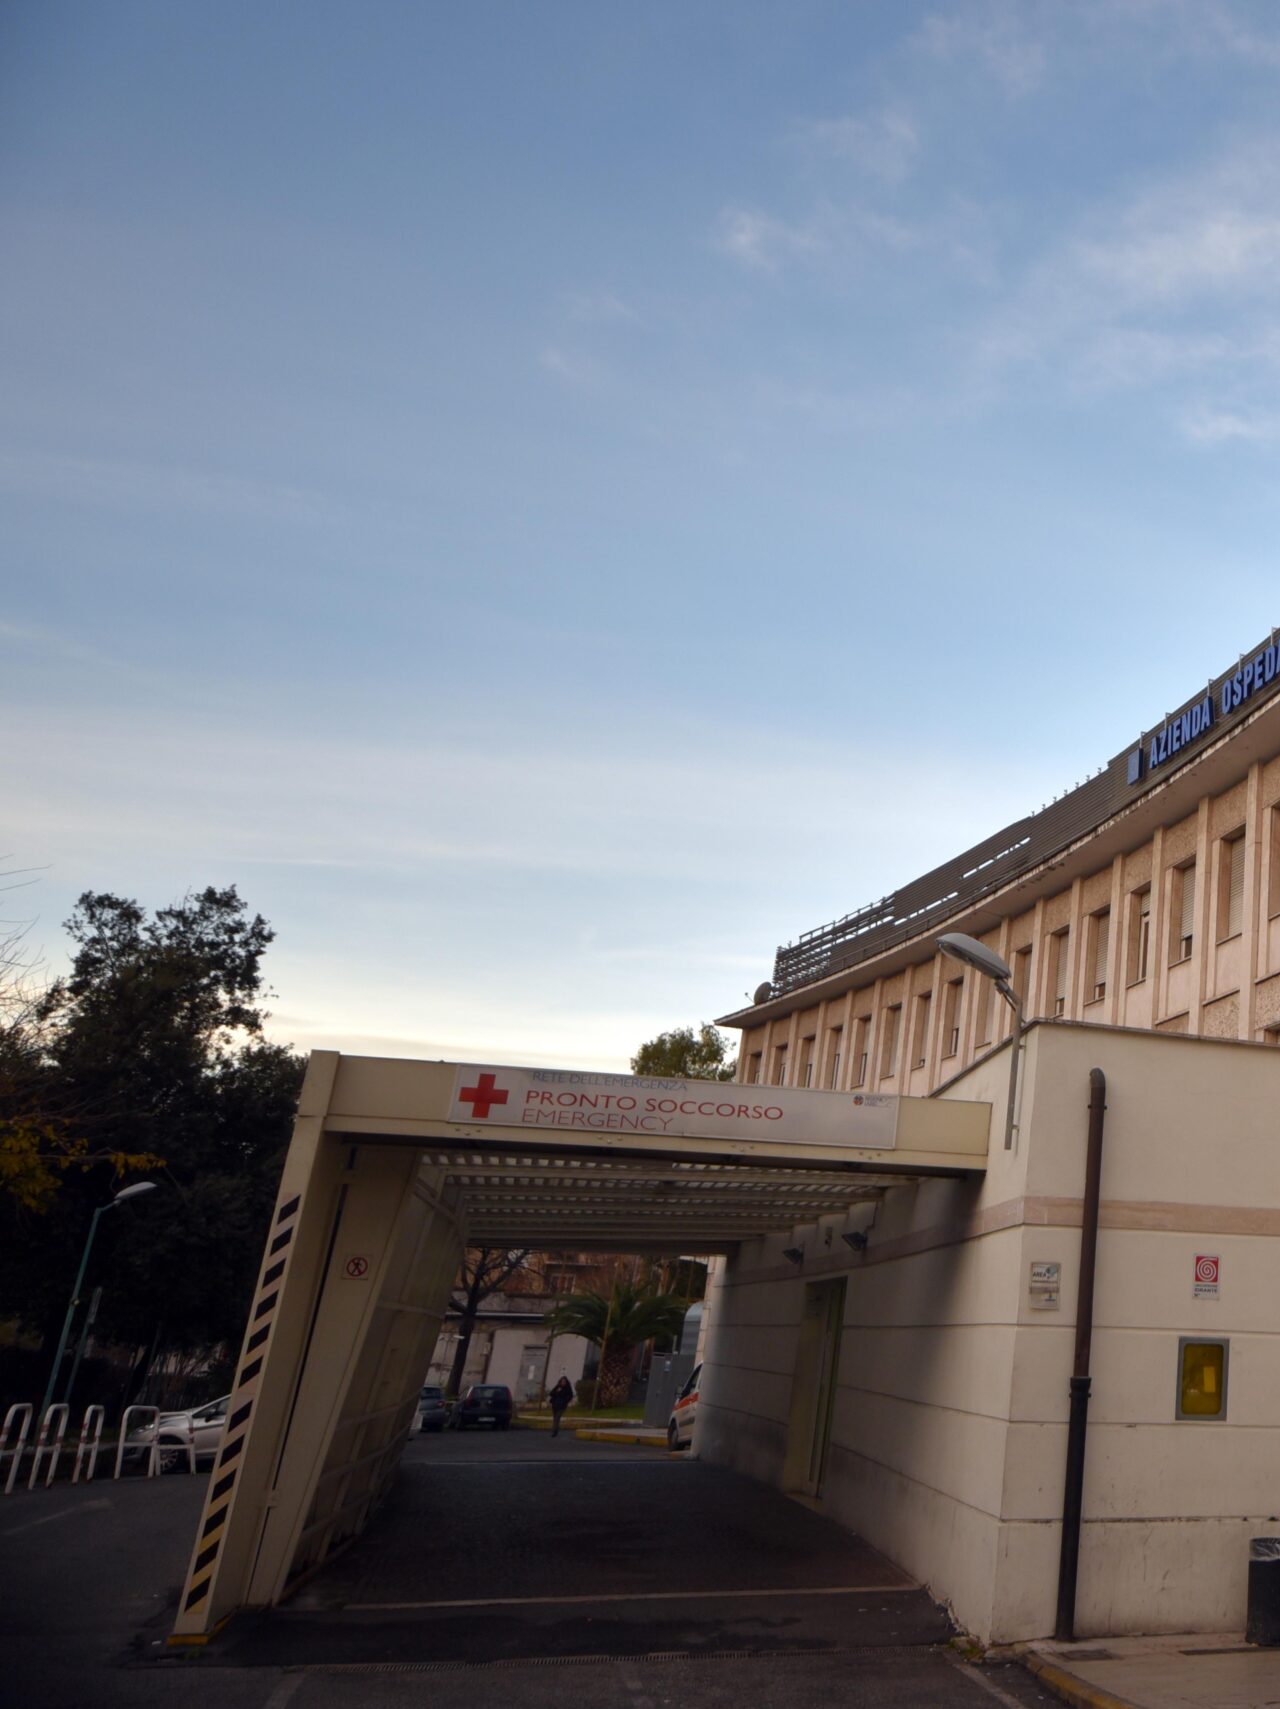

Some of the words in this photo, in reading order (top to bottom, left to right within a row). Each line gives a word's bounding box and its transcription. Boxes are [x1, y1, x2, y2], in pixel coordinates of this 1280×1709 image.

[1149, 695, 1215, 769] AZIENDA
[532, 1071, 566, 1084] RETE
[525, 1090, 637, 1111] PRONTO
[644, 1098, 784, 1121] SOCCORSO
[521, 1108, 674, 1132] EMERGENCY
